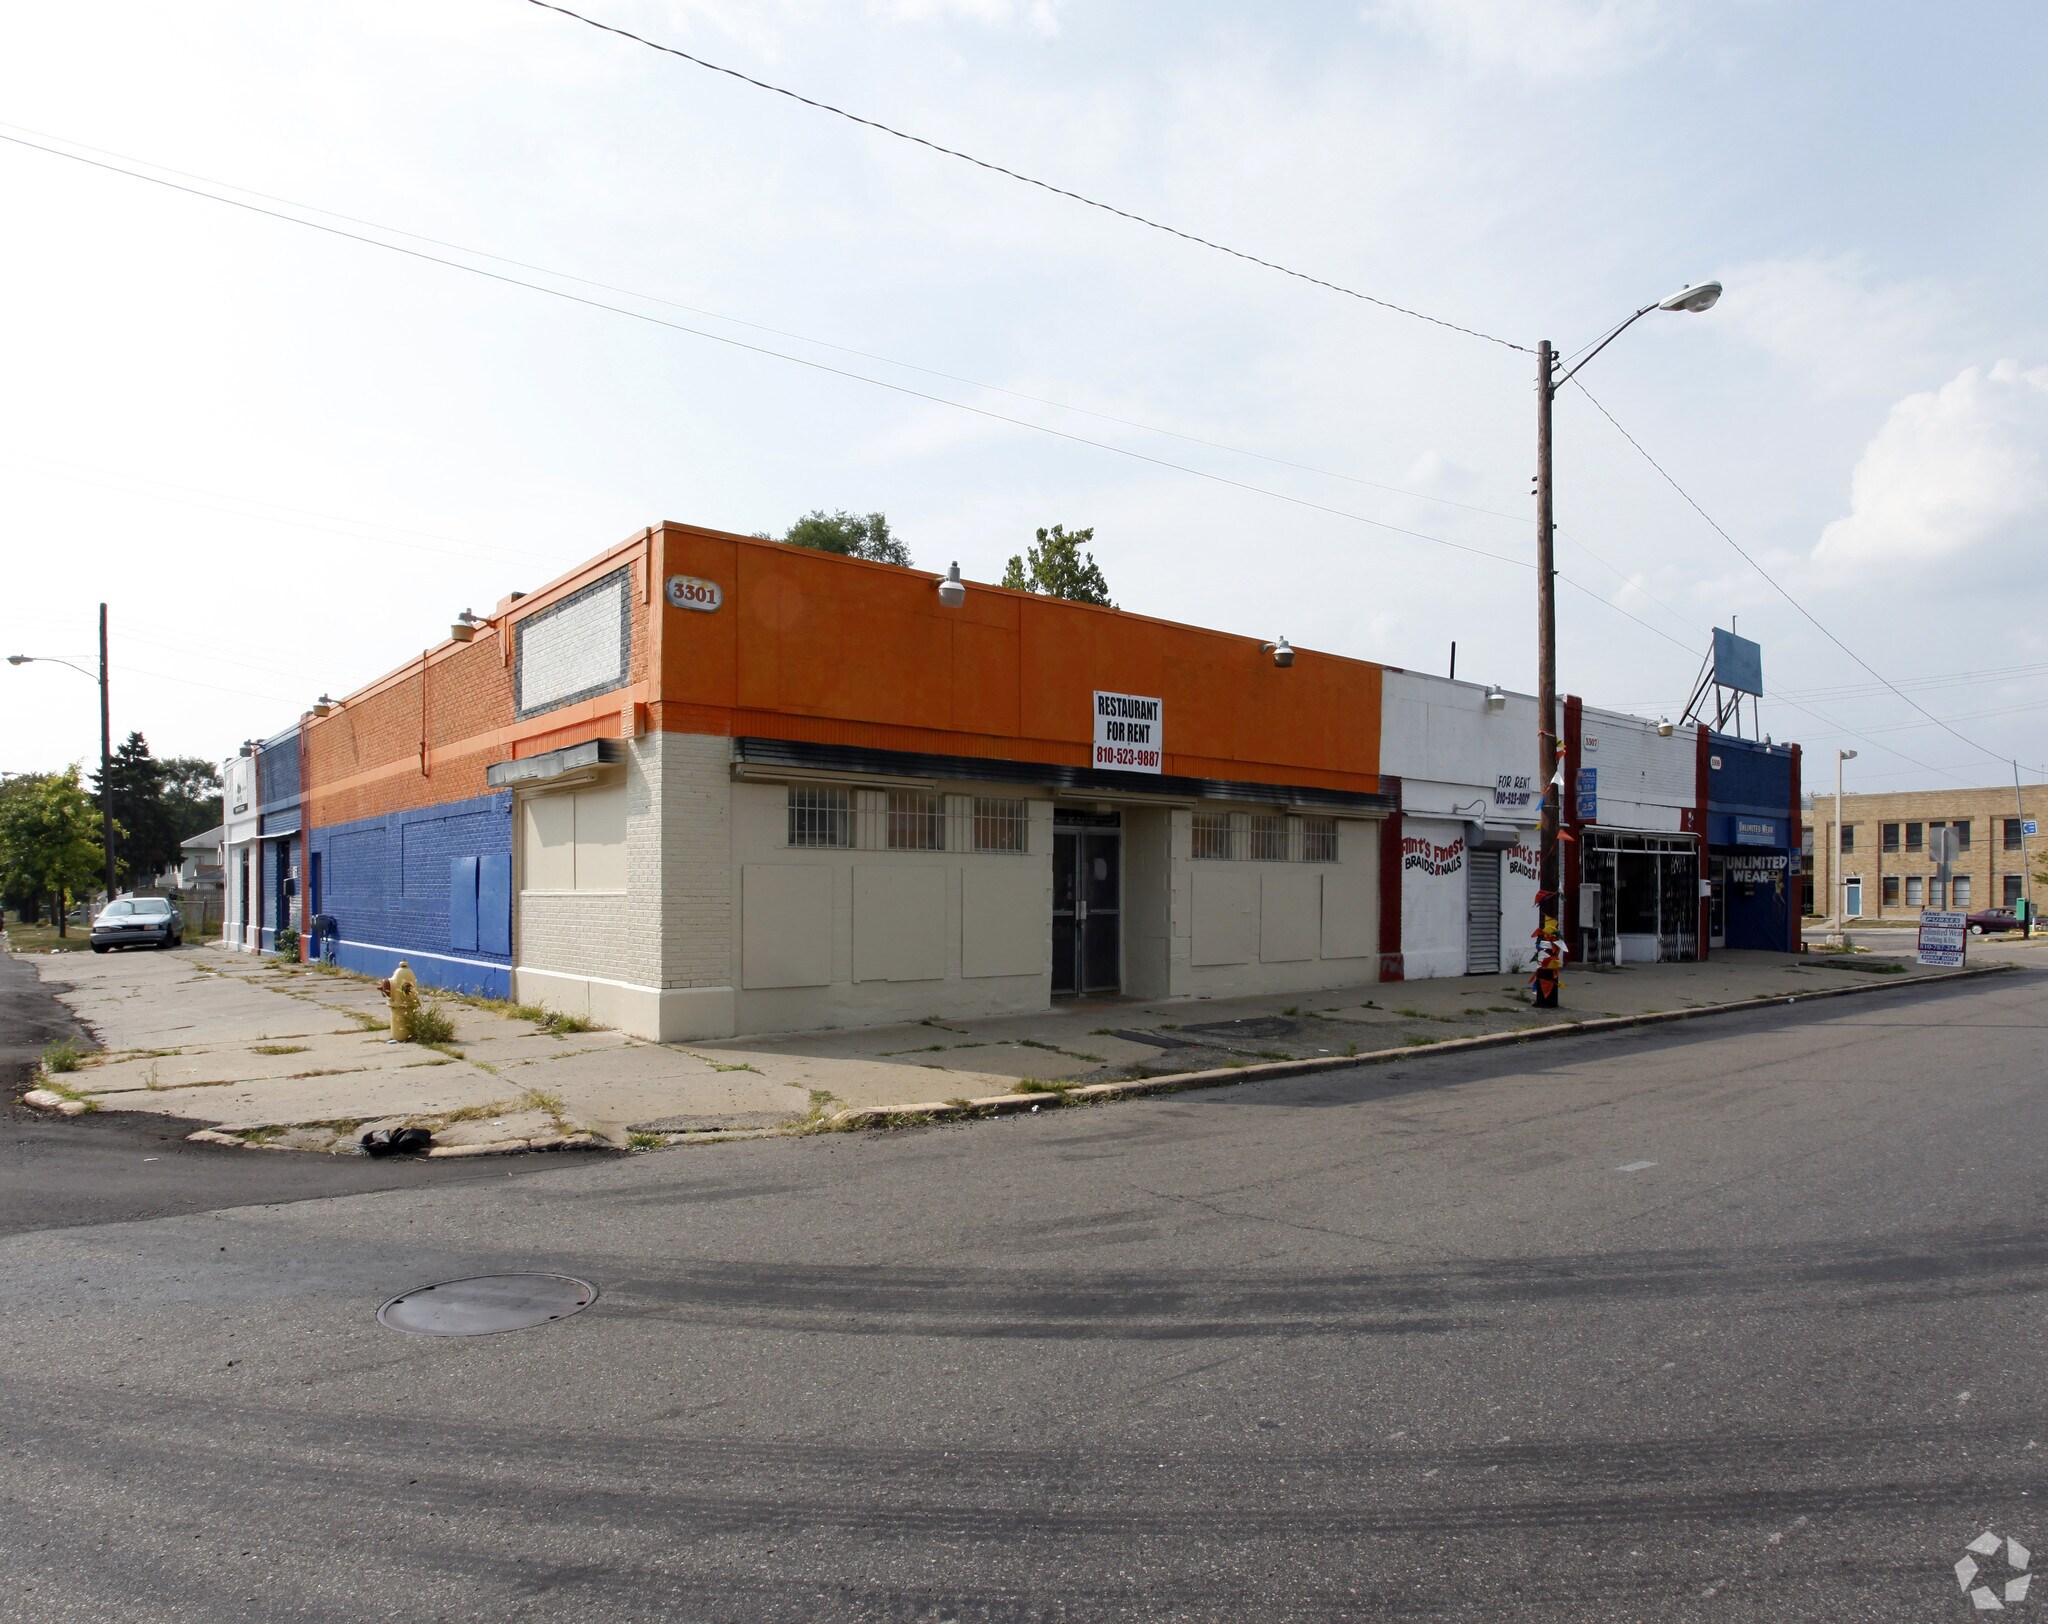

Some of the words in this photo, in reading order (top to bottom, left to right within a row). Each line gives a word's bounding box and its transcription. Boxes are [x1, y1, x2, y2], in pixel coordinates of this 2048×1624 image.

[673, 583, 716, 604] 3301
[1098, 696, 1158, 721] RESTAURANT
[1107, 721, 1125, 741] FOR
[1127, 723, 1150, 743] RENT
[1097, 746, 1159, 767] 810-523-9887
[1498, 775, 1512, 788] FOR
[1514, 776, 1531, 789] RENT
[1405, 855, 1435, 875] BRAIDS
[1435, 864, 1441, 876] &
[1441, 856, 1462, 875] NAILS
[1510, 861, 1532, 879] BRAIDS
[1727, 856, 1788, 869] UNLIMITED
[1733, 869, 1769, 883] WEAR
[1921, 928, 1948, 936] Unlimited
[1949, 929, 1964, 937] Wear
[1924, 935, 1943, 943] Clothing
